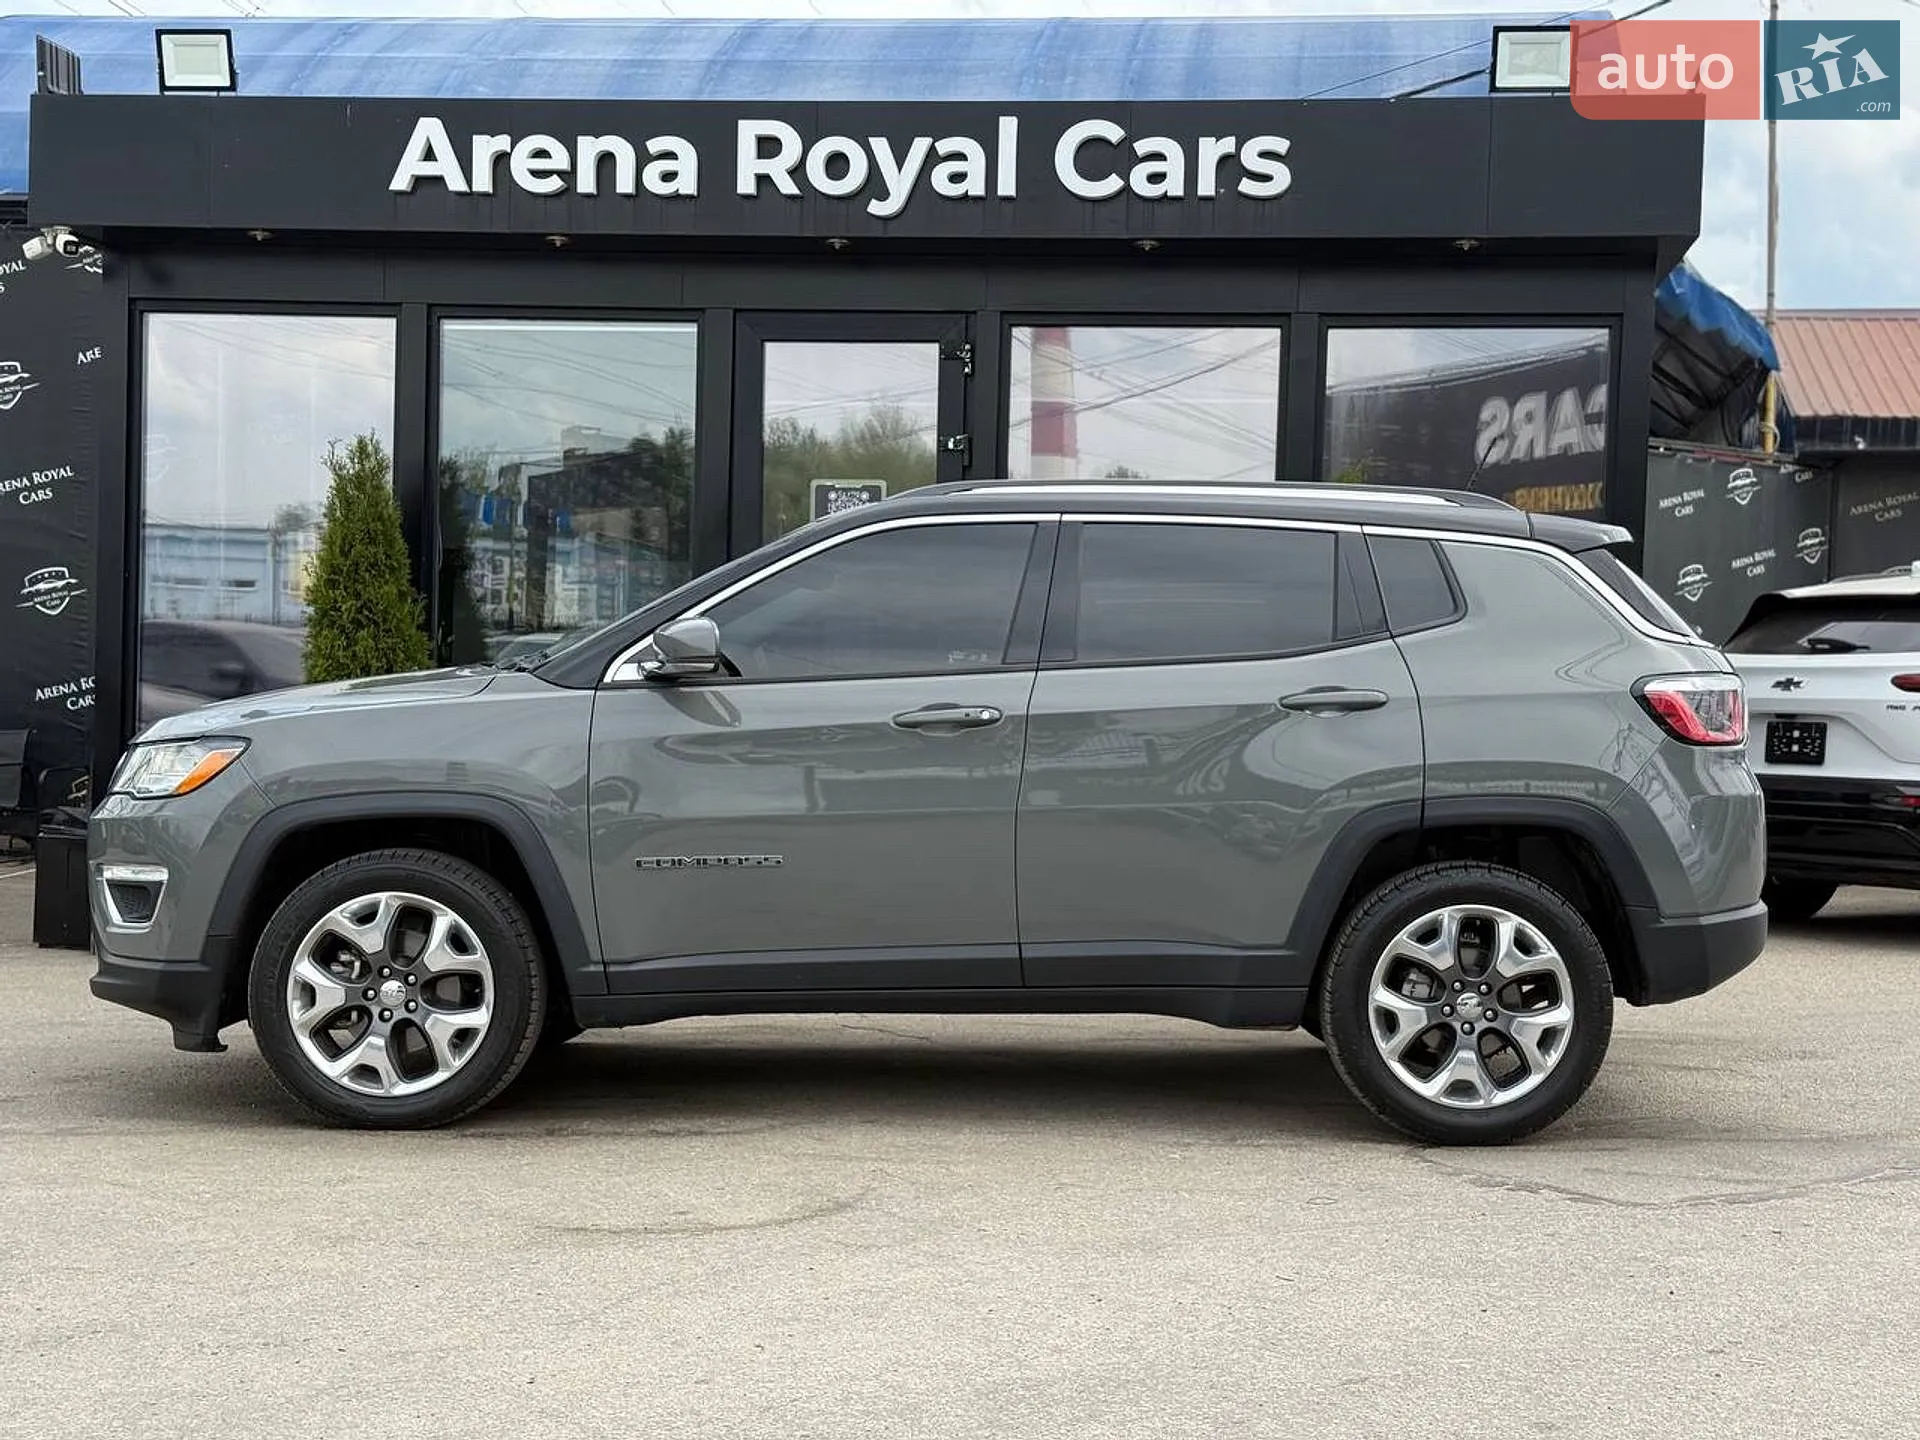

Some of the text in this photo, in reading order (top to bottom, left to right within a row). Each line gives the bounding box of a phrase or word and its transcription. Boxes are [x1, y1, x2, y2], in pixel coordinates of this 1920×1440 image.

[388, 115, 1293, 219] Arena Royal Cars
[32, 466, 75, 485] ROYAL
[19, 488, 53, 505] CARS
[35, 682, 78, 701] ARENA
[67, 694, 96, 710] CAR
[635, 855, 784, 870] COMPASS
